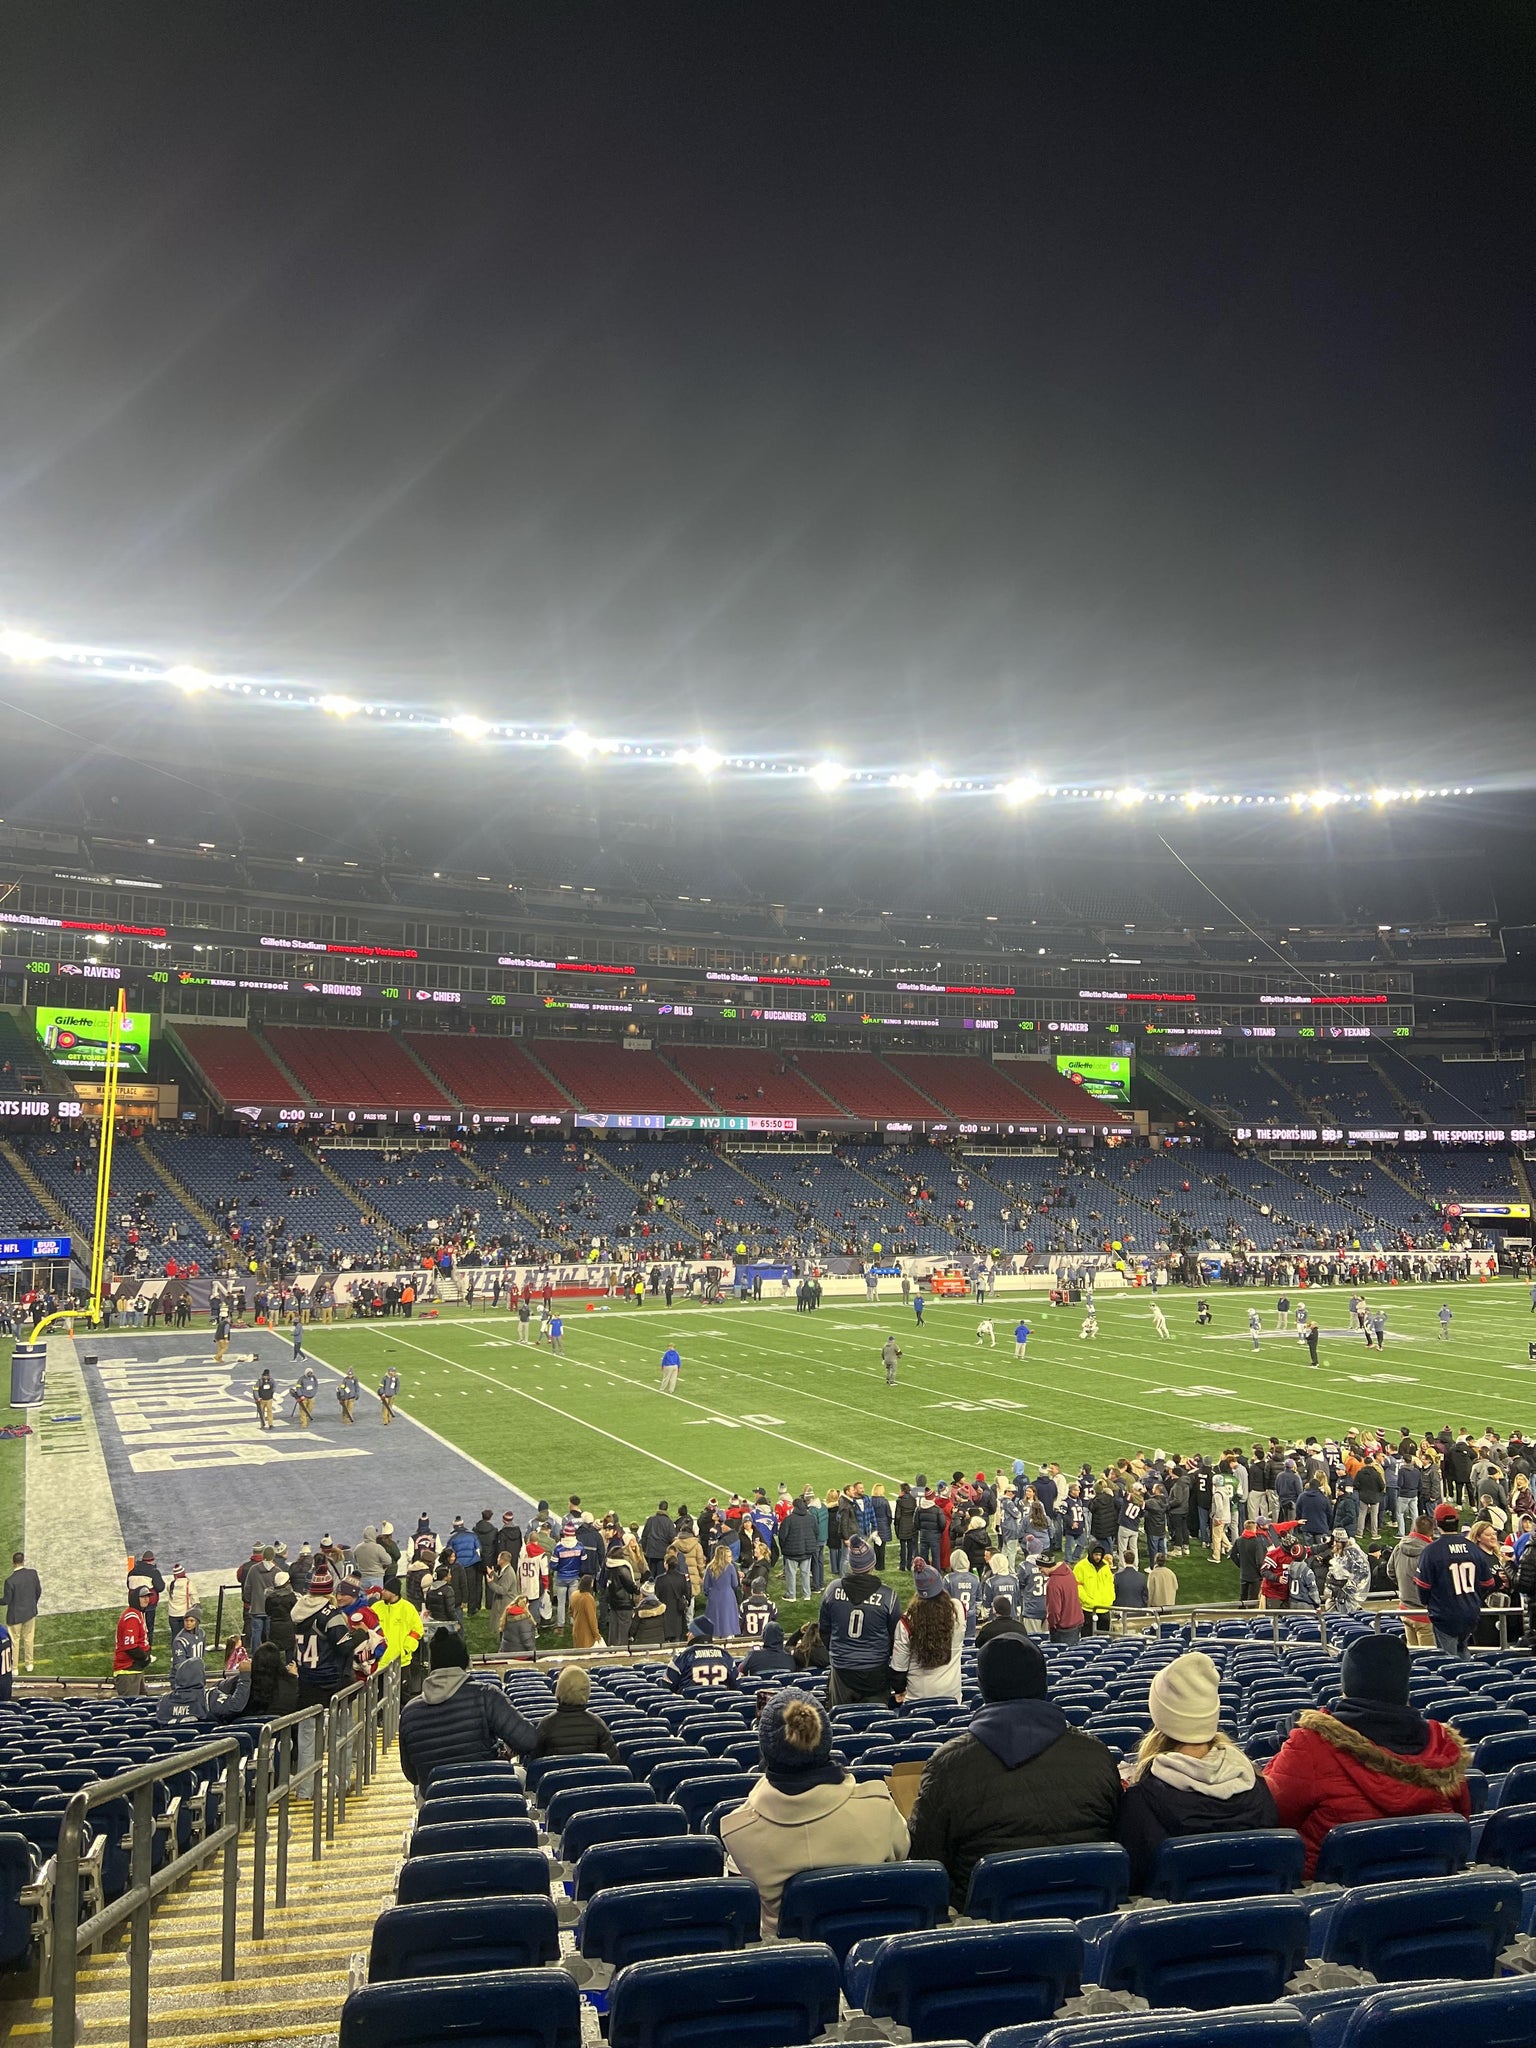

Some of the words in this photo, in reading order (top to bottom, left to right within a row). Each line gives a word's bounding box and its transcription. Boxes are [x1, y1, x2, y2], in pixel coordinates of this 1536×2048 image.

[20, 914, 62, 927] Stadium
[62, 921, 104, 931] powered
[260, 937, 291, 948] Gillette
[292, 939, 327, 950] Stadium
[327, 944, 365, 954] powered
[374, 947, 405, 957] Verizon
[26, 962, 50, 974] +360
[498, 957, 525, 967] Gillette
[525, 959, 556, 969] Stadium
[557, 962, 589, 971] powered
[598, 964, 624, 973] Verizon
[84, 965, 120, 980] RAVENS
[147, 971, 168, 983] -470
[706, 972, 731, 981] Gillette
[731, 974, 758, 982] Stadium
[759, 976, 787, 984] powered
[239, 980, 288, 991] SPORTSBOOK
[322, 984, 361, 998] BRONCOS
[381, 988, 399, 998] +170
[896, 982, 919, 990] Gillette
[920, 984, 945, 992] Stadium
[433, 991, 460, 1003] CHIEFS
[487, 995, 506, 1005] -205
[592, 1004, 632, 1012] SPORTSBOOK
[673, 1006, 693, 1016] BILLS
[720, 1009, 737, 1019] -250
[55, 1016, 93, 1027] Gillette
[764, 1010, 807, 1021] BUCCANEERS
[810, 1013, 827, 1022] +205
[904, 1018, 939, 1026] SPORTSBOOK
[976, 1020, 999, 1029] GIANTS
[1018, 1021, 1034, 1030] +320
[1060, 1023, 1089, 1033] PACKERS
[1253, 1028, 1276, 1037] TITANS
[1298, 1028, 1315, 1037] +225
[1343, 1028, 1371, 1037] TEXANS
[21, 1102, 50, 1116] HUB
[280, 1109, 305, 1120] 0:00
[347, 1111, 356, 1121] 0
[412, 1112, 421, 1122] 0
[472, 1113, 480, 1123] 0
[530, 1114, 561, 1125] Gillette
[618, 1117, 633, 1126] NE
[645, 1117, 651, 1126] 0
[700, 1118, 721, 1128] NYJ
[729, 1119, 736, 1128] 0
[760, 1120, 782, 1128] 65:50
[959, 1124, 978, 1133] 0:00
[1008, 1125, 1014, 1134] 0
[1057, 1125, 1063, 1134] 0
[1102, 1127, 1109, 1135] 0
[1257, 1130, 1271, 1139] THE
[1271, 1130, 1300, 1140] SPORTS
[1300, 1130, 1317, 1140] HUB
[1322, 1130, 1343, 1140] 98.5
[1404, 1131, 1426, 1141] 98.5
[1432, 1131, 1450, 1140] THE
[1450, 1131, 1484, 1141] SPORTS
[1485, 1131, 1505, 1140] HUB
[3, 1243, 20, 1253] NFL
[33, 1247, 60, 1255] LIGHT
[1071, 1505, 1085, 1522] 12
[1124, 1502, 1141, 1520] 10
[1448, 1543, 1472, 1554] MAYE
[521, 1561, 535, 1578] 95
[1448, 1561, 1476, 1595] 10
[745, 1612, 770, 1634] 87
[847, 1608, 865, 1639] 0
[124, 1635, 135, 1645] 24
[191, 1641, 204, 1659] 10
[694, 1649, 723, 1659] JOHNSON
[692, 1664, 729, 1686] 52
[172, 1705, 190, 1716] MAYE
